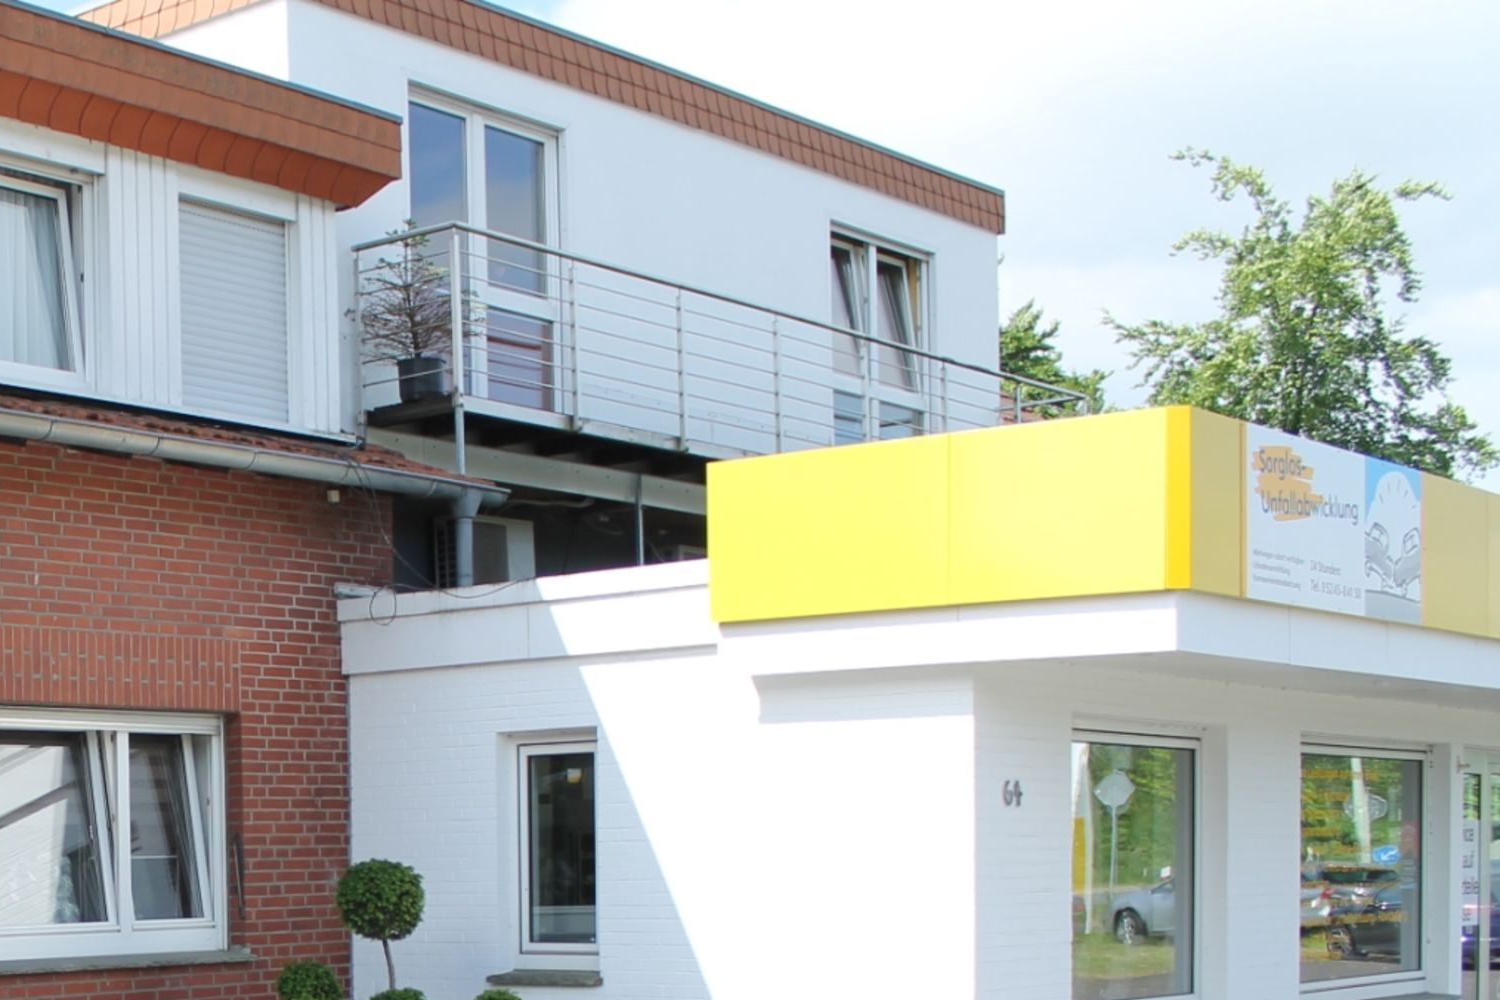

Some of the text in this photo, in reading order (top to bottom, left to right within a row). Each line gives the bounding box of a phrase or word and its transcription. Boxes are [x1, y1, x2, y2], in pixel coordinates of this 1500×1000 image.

[1258, 449, 1307, 480] Sorglos-
[1260, 489, 1359, 526] Unfallabwicklung
[1002, 779, 1023, 807] 64
